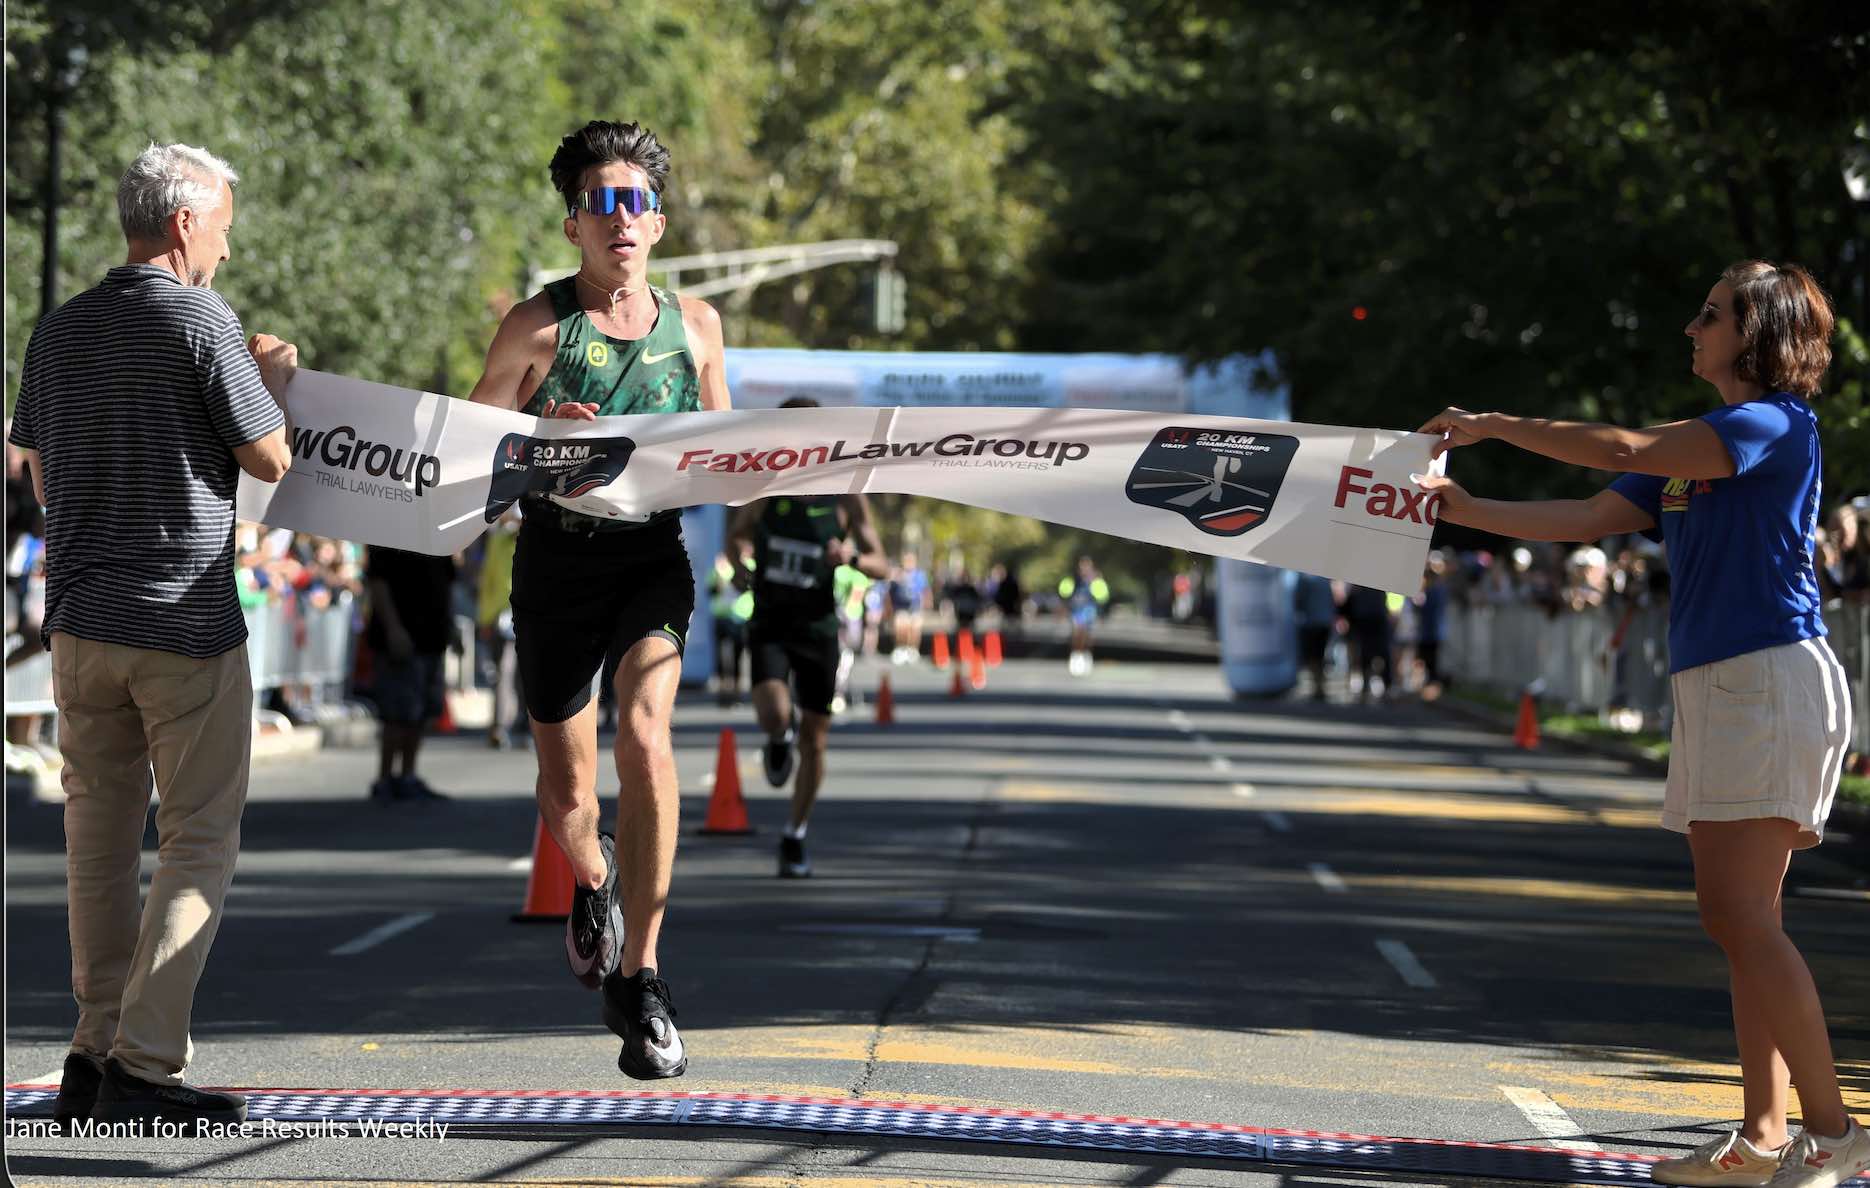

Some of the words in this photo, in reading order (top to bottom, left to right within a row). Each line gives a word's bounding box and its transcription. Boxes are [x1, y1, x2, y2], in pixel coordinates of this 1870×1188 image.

[1197, 432, 1220, 442] 20
[1225, 434, 1256, 445] KM
[533, 446, 555, 460] 20
[560, 445, 591, 460] KM
[1160, 442, 1189, 450] USATF
[1195, 440, 1272, 453] CHAMPIONSHIPS
[676, 433, 1091, 474] FaxonLawGroup
[504, 462, 528, 472] USATF
[932, 459, 972, 468] TRIAL
[975, 460, 1050, 471] LAWYERS
[314, 470, 348, 491] TRIAL
[350, 480, 413, 503] LAWYERS
